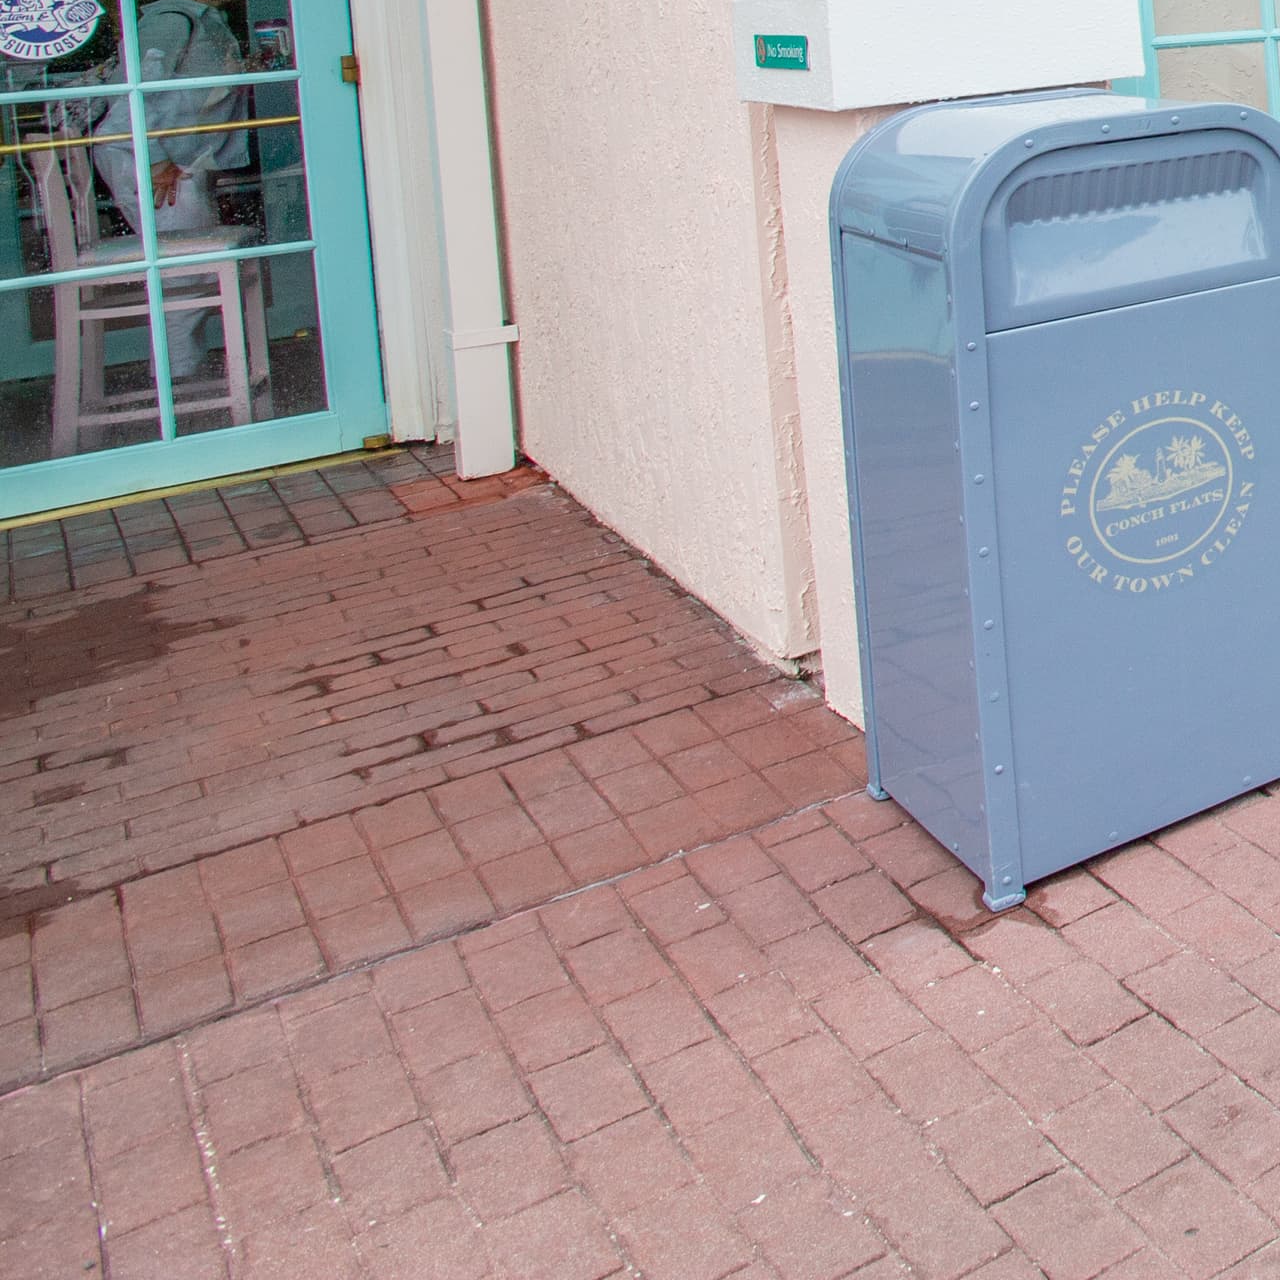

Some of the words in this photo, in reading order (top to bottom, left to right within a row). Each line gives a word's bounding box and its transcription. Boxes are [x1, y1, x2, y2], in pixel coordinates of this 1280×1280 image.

[4, 33, 83, 57] SUITCASE
[767, 44, 776, 57] No
[777, 43, 804, 63] Smoking
[1060, 410, 1126, 517] PLEASE
[1131, 390, 1207, 415] HELP
[1209, 400, 1255, 461] KEEP
[1066, 535, 1108, 584] OUR
[1113, 564, 1194, 593] TOWN
[1201, 480, 1255, 566] CLEAN
[1105, 507, 1165, 537] CONCH
[1169, 488, 1225, 514] FLATS
